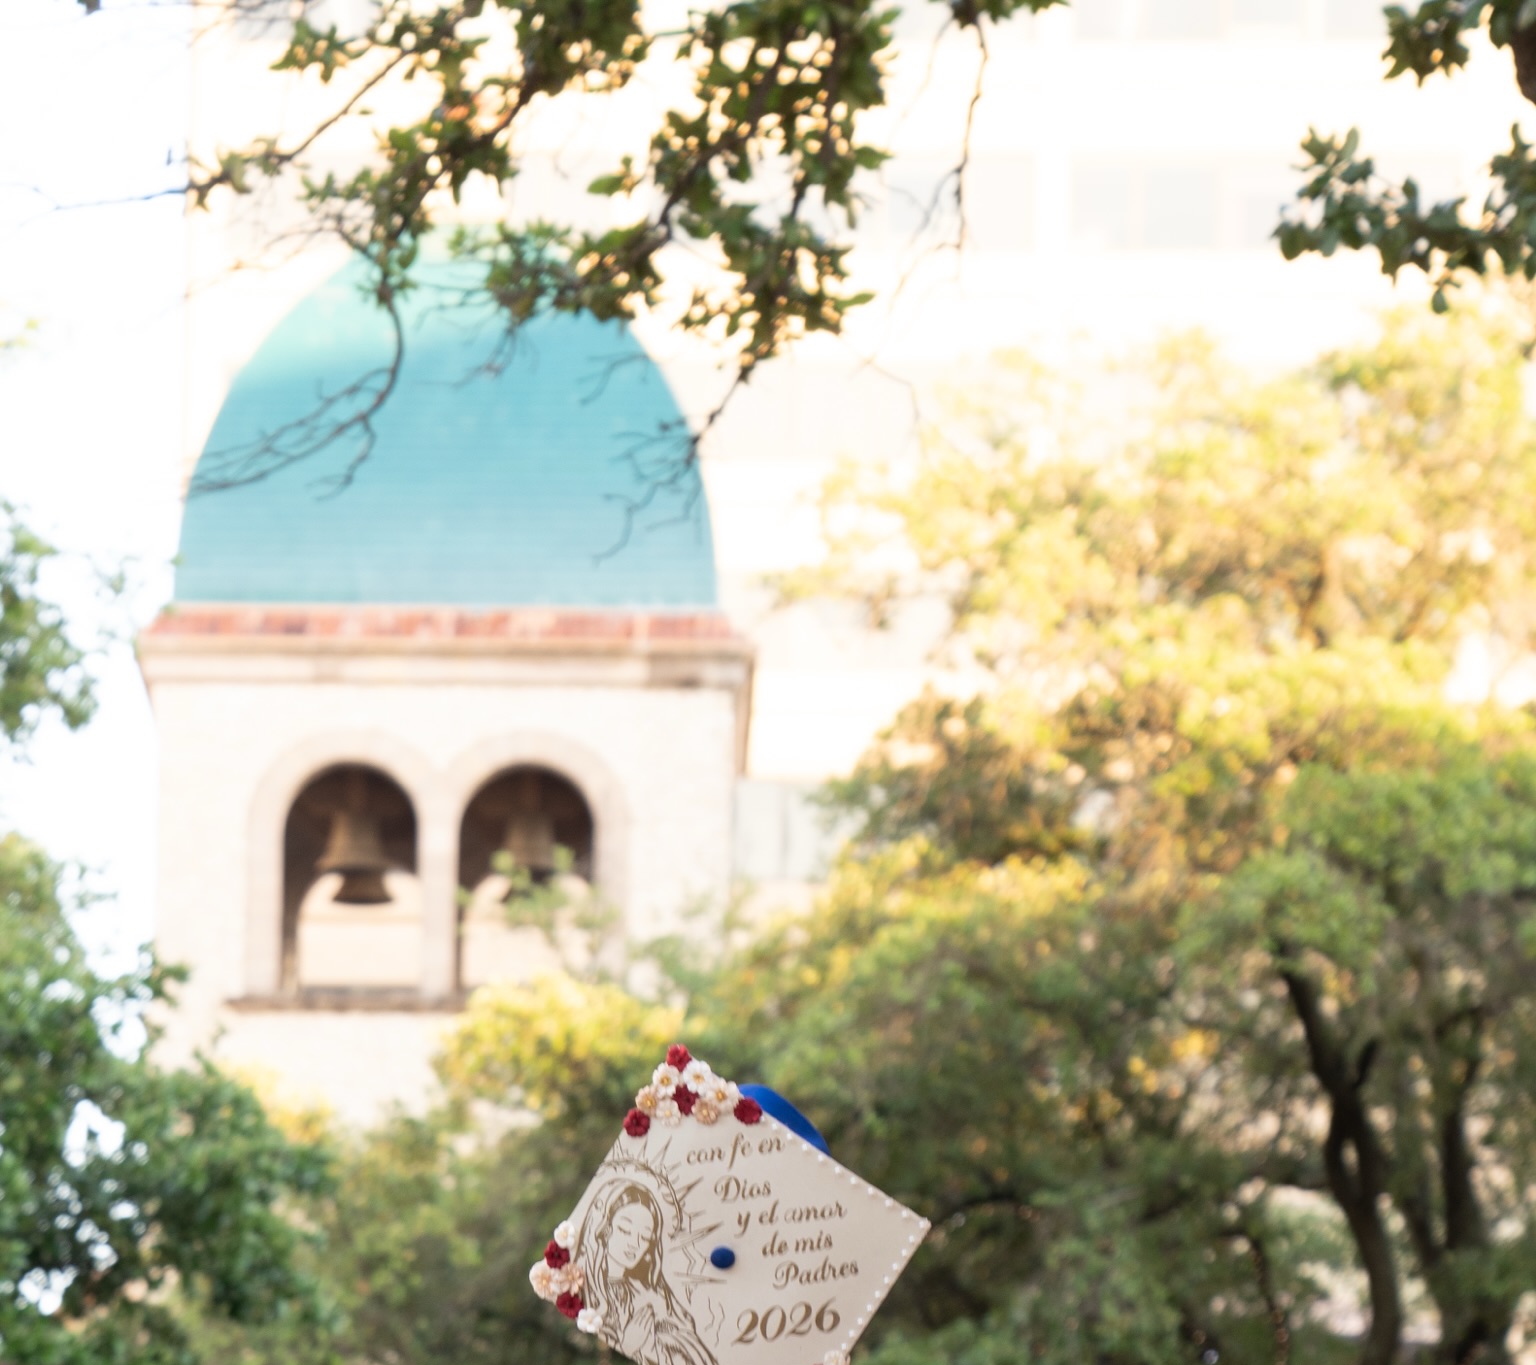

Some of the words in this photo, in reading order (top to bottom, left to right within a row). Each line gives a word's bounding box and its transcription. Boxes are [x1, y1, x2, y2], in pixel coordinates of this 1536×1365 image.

[686, 1147, 724, 1165] con
[728, 1132, 752, 1171] fe
[758, 1136, 785, 1155] en
[714, 1174, 772, 1203] Dios
[734, 1210, 751, 1238] y
[758, 1200, 779, 1225] el
[784, 1200, 848, 1225] amor
[762, 1230, 788, 1257] de
[794, 1229, 833, 1253] mis
[772, 1255, 859, 1290] Padres
[730, 1297, 841, 1346] 2026
